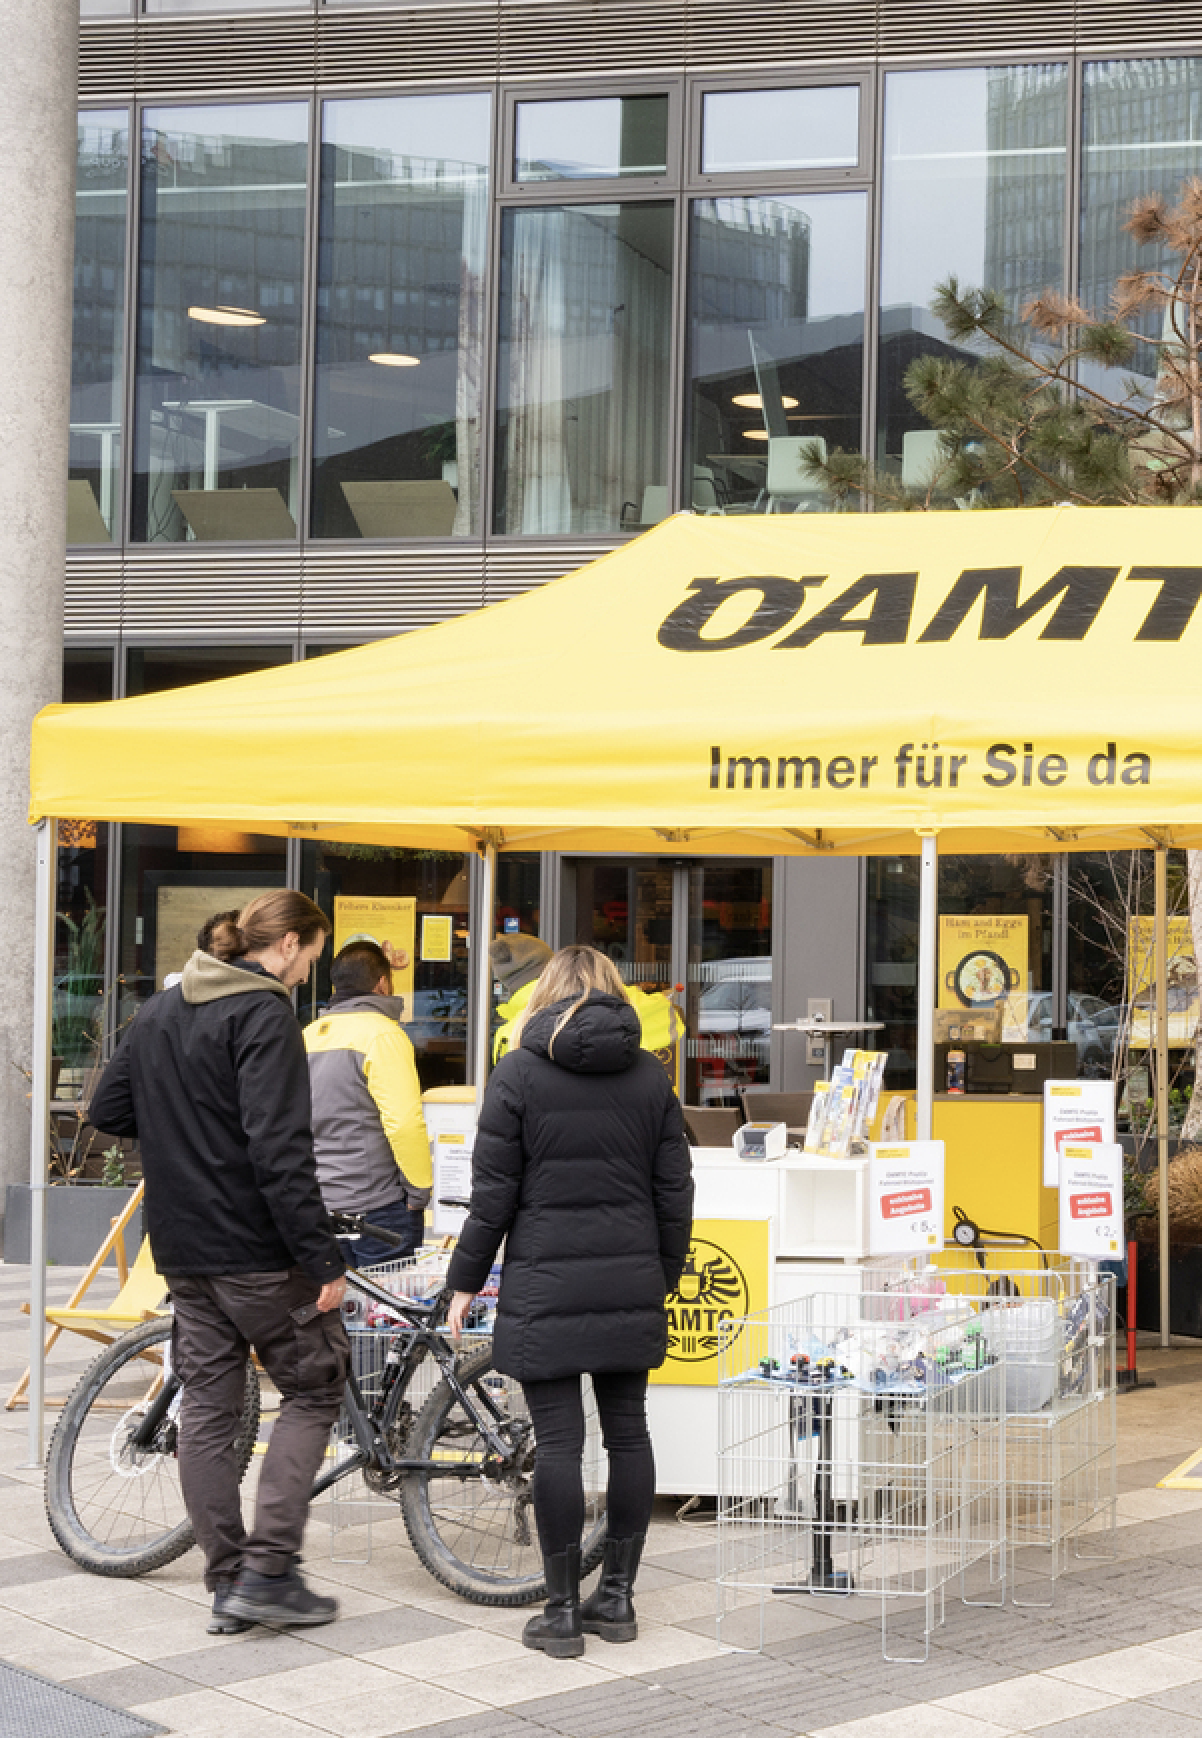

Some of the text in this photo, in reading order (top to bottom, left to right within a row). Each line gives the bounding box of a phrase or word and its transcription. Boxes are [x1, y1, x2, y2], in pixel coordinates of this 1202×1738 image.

[709, 741, 1151, 789] Immer für Sie da
